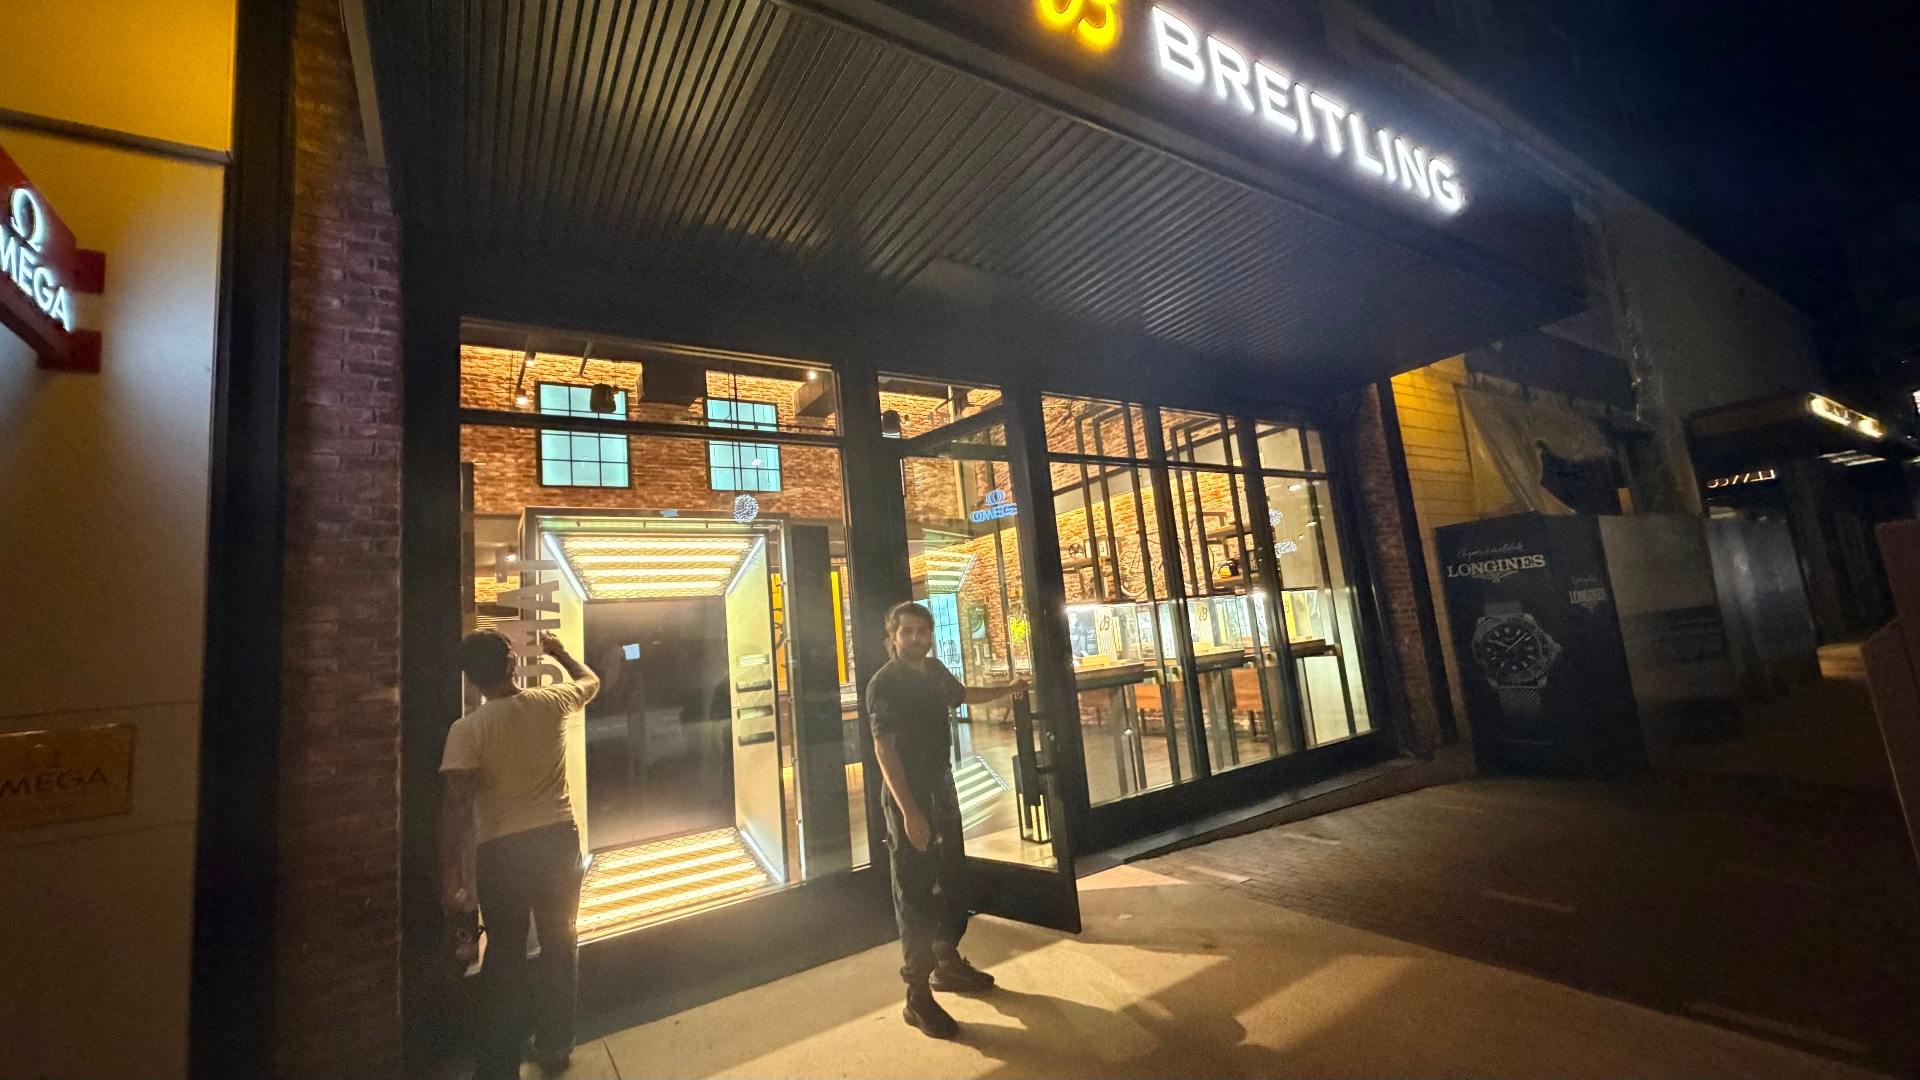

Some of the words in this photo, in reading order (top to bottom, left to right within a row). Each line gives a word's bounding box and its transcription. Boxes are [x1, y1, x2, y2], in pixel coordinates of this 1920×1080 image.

[1152, 5, 1466, 213] BREITLING
[0, 224, 72, 333] MEGA
[970, 503, 1018, 523] OMEG
[1447, 554, 1546, 578] LONGINES
[0, 766, 110, 797] MEGA
